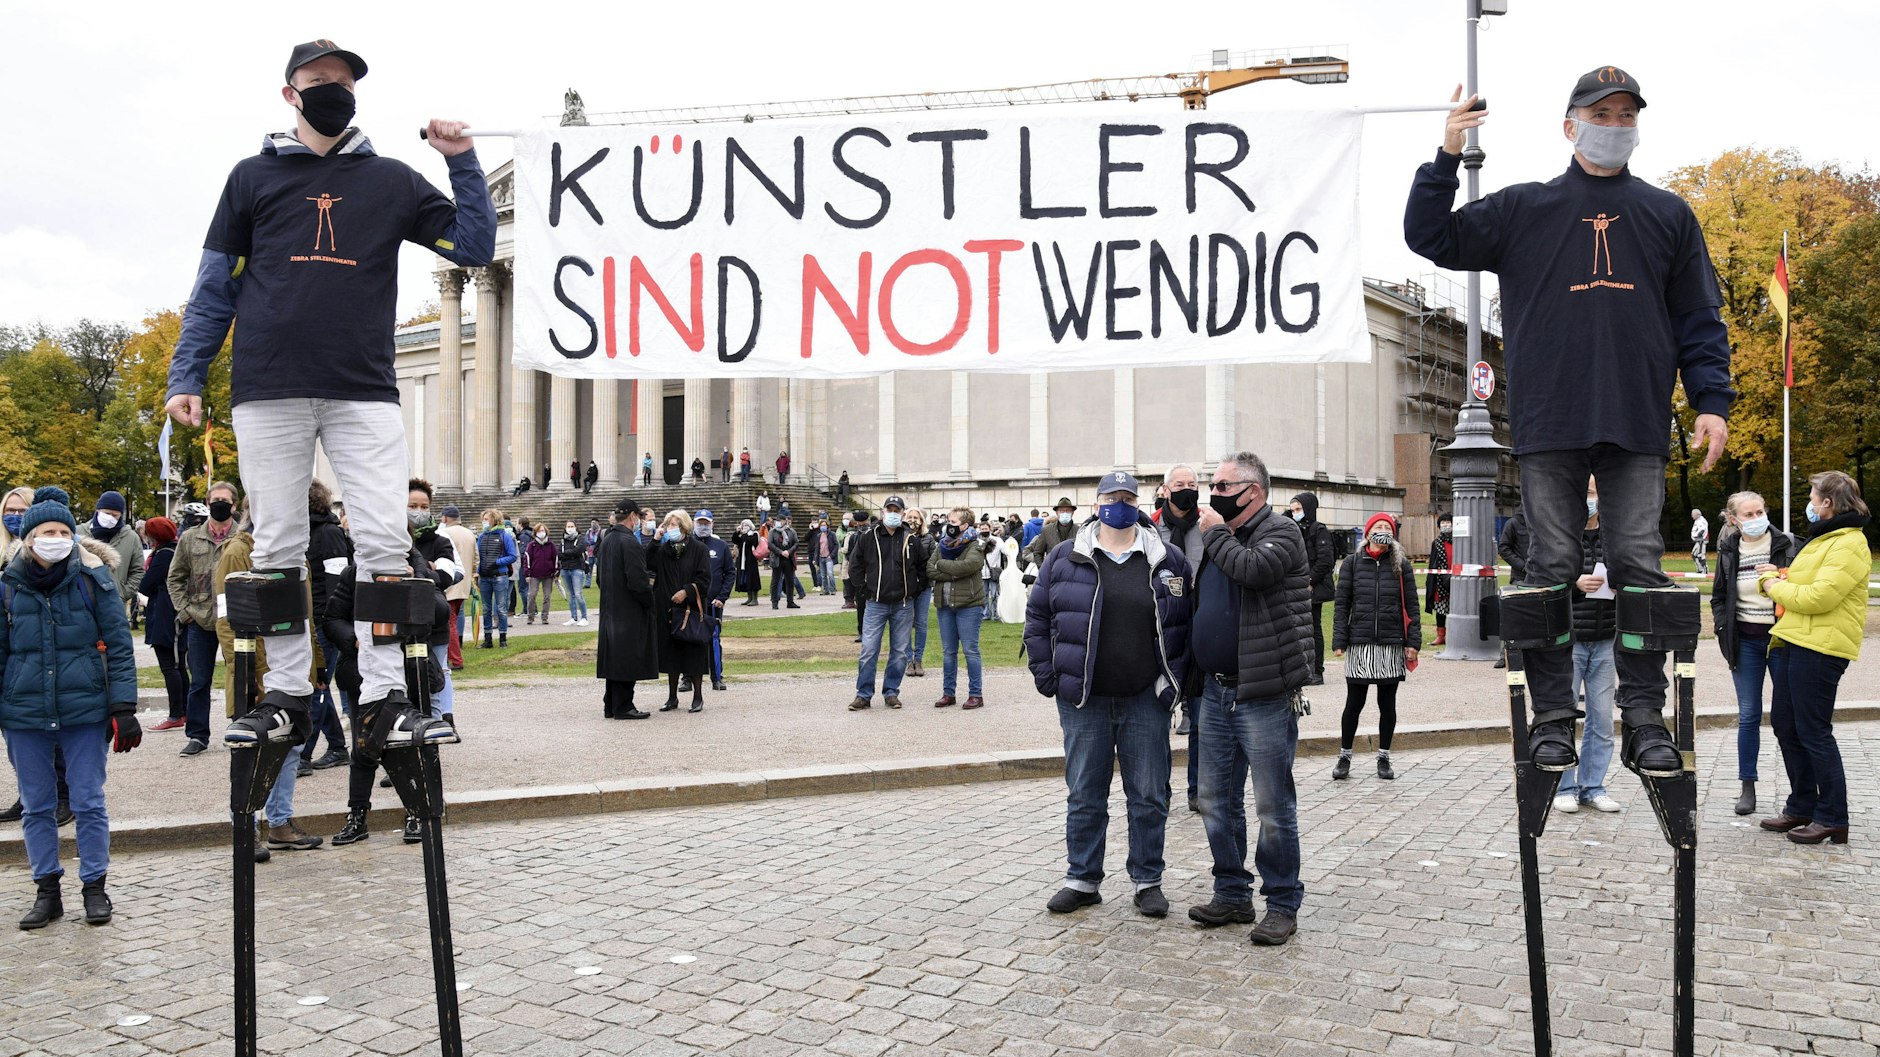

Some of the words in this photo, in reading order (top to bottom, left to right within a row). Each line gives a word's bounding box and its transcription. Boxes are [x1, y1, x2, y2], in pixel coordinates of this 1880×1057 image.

[549, 122, 1256, 230] KÜNSTLER
[310, 255, 358, 266] STELZENTHEATER
[1569, 283, 1590, 292] ZEBRA
[549, 253, 763, 363] SIND
[801, 231, 1321, 359] NOTWENDIG
